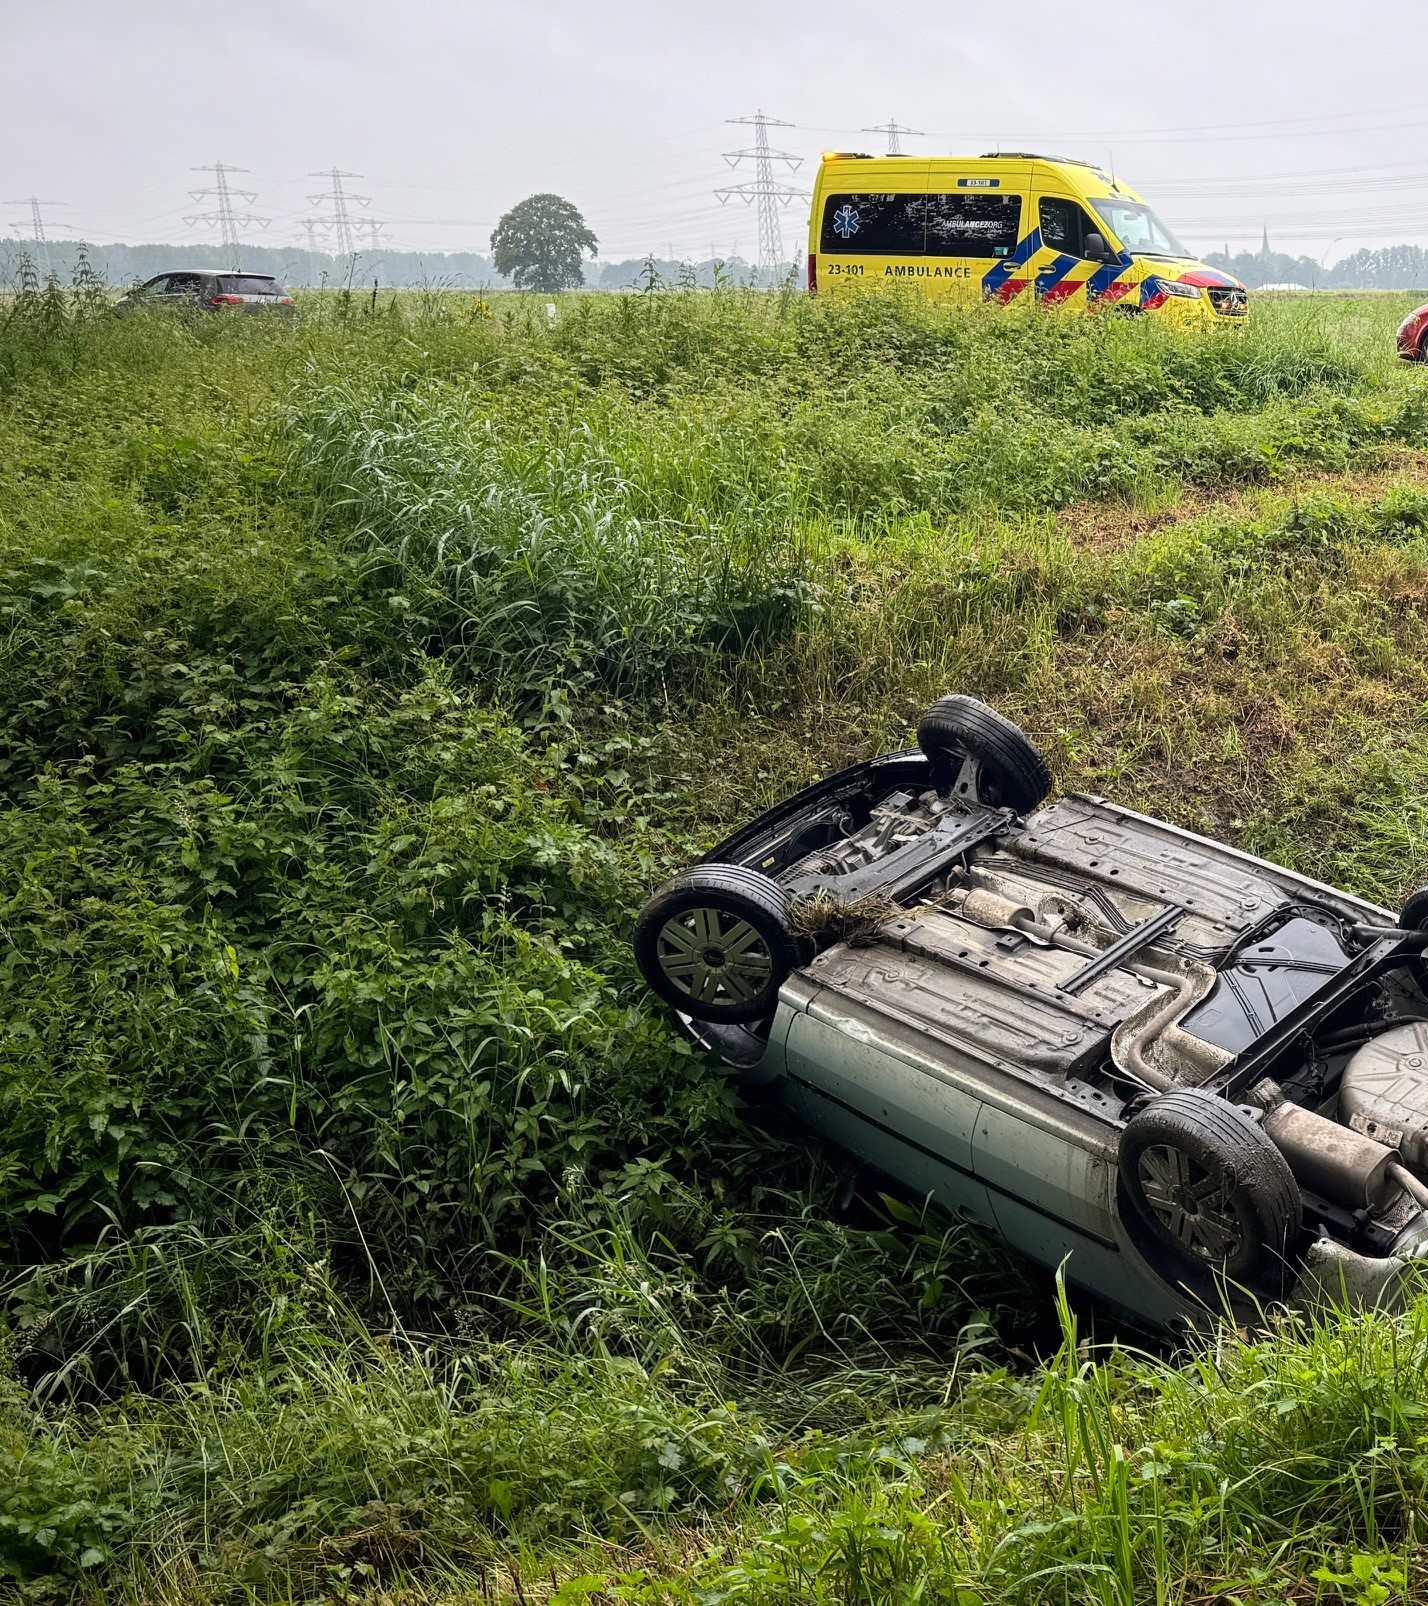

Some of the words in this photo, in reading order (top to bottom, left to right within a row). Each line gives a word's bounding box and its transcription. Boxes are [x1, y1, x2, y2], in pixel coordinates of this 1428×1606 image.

[941, 220, 1003, 229] AMBULANCEZORG
[828, 264, 865, 276] 23-101
[884, 265, 971, 279] AMBULANCE
